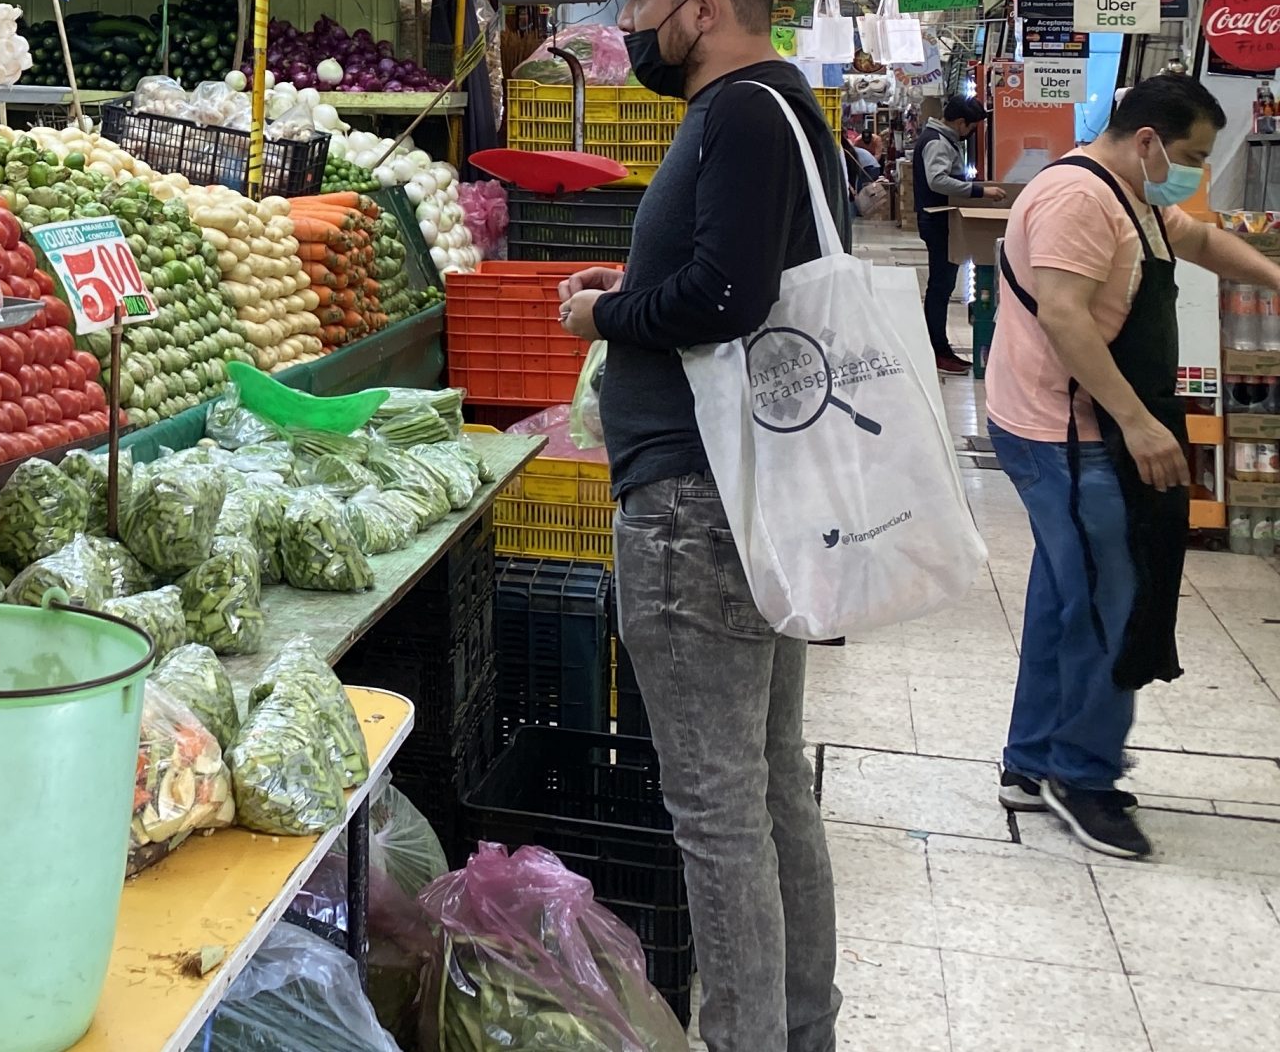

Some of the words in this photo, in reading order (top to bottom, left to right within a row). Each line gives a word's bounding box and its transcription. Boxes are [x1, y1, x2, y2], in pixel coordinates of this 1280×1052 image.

[1096, 13, 1136, 26] Eats
[911, 68, 942, 86] EXACTO
[1040, 76, 1070, 87] Uber
[1040, 88, 1070, 98] Eats
[40, 226, 86, 250] ¡QUIERO
[755, 352, 901, 409] Transparencia
[841, 509, 913, 546] @TranparenciaCM
